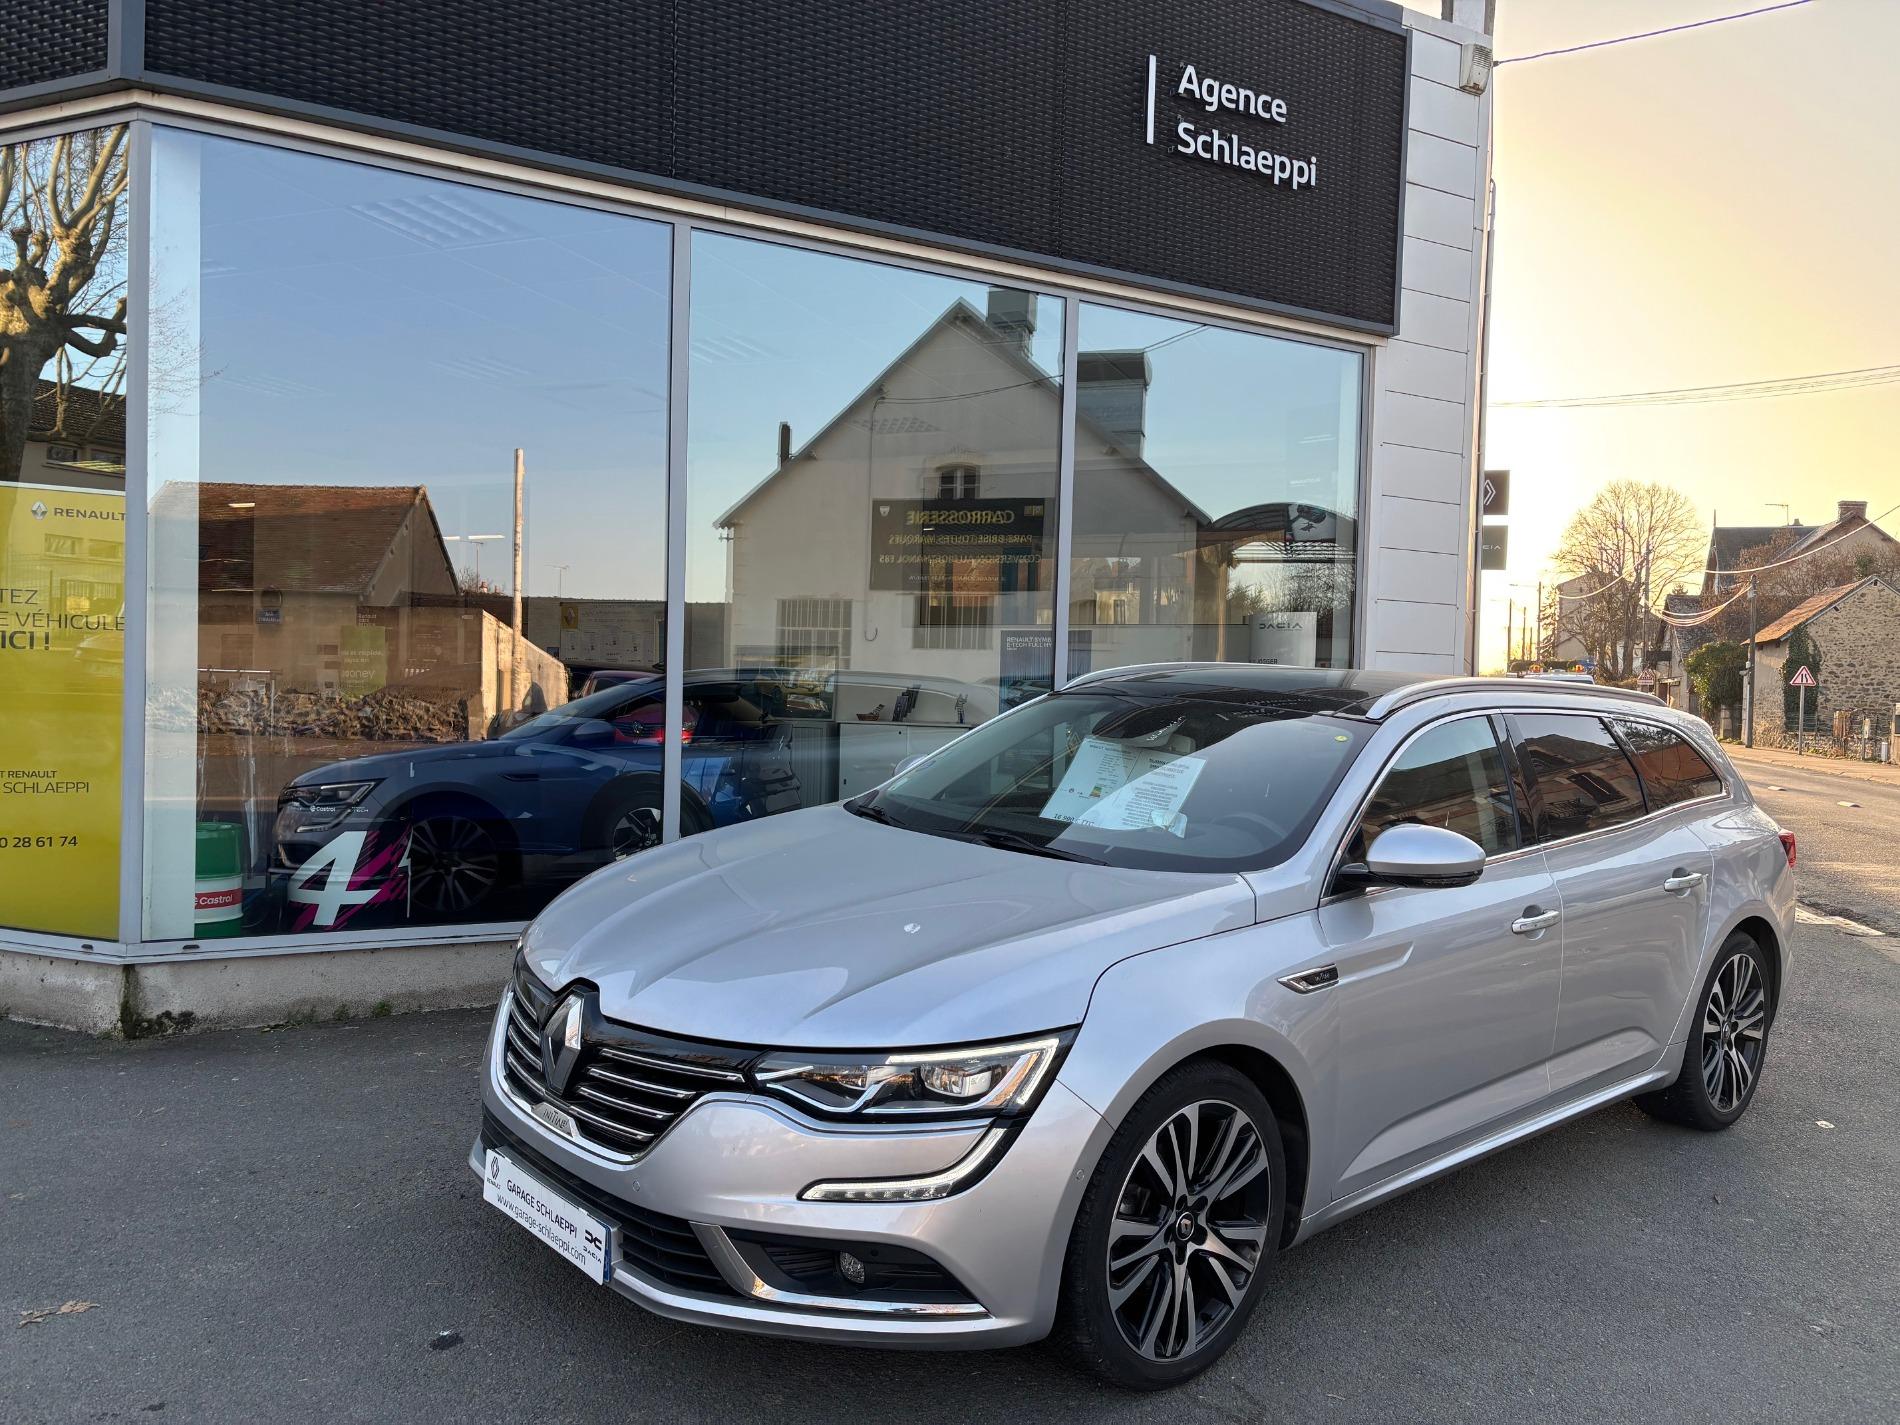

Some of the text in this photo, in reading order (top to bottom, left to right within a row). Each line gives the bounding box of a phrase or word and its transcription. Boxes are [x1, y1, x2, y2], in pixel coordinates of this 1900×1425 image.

[1177, 65, 1288, 123] Agence
[1177, 122, 1317, 190] Schlaeppi
[54, 507, 126, 521] RENAULT
[15, 609, 125, 632] VÉHICULE
[44, 632, 50, 651] !
[7, 770, 57, 779] RENAULT
[3, 781, 90, 794] SCHLAEPPI
[12, 837, 32, 848] 28
[36, 836, 53, 848] 61
[60, 836, 79, 847] 74
[287, 830, 382, 926] 4
[199, 894, 233, 905] Castrol
[506, 1179, 578, 1239] GARAGE SCHLAEPPI
[496, 1193, 587, 1266] www.garage-schlaeppi.com
